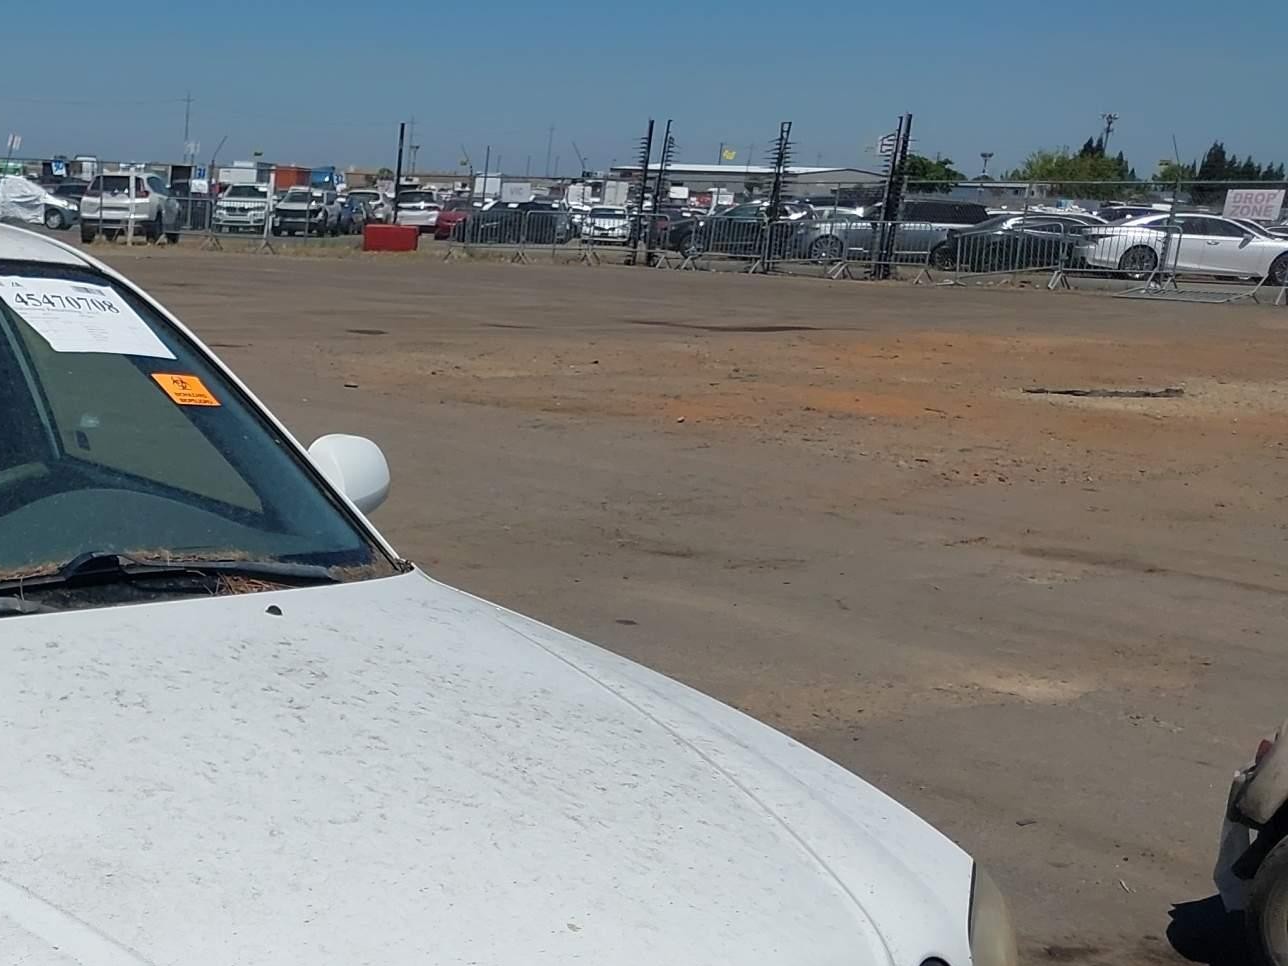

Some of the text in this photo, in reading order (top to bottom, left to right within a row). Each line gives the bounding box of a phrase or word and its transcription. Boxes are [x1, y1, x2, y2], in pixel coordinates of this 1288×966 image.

[1232, 192, 1277, 204] DROP
[1230, 205, 1274, 217] ZONE
[14, 292, 121, 314] 45470708
